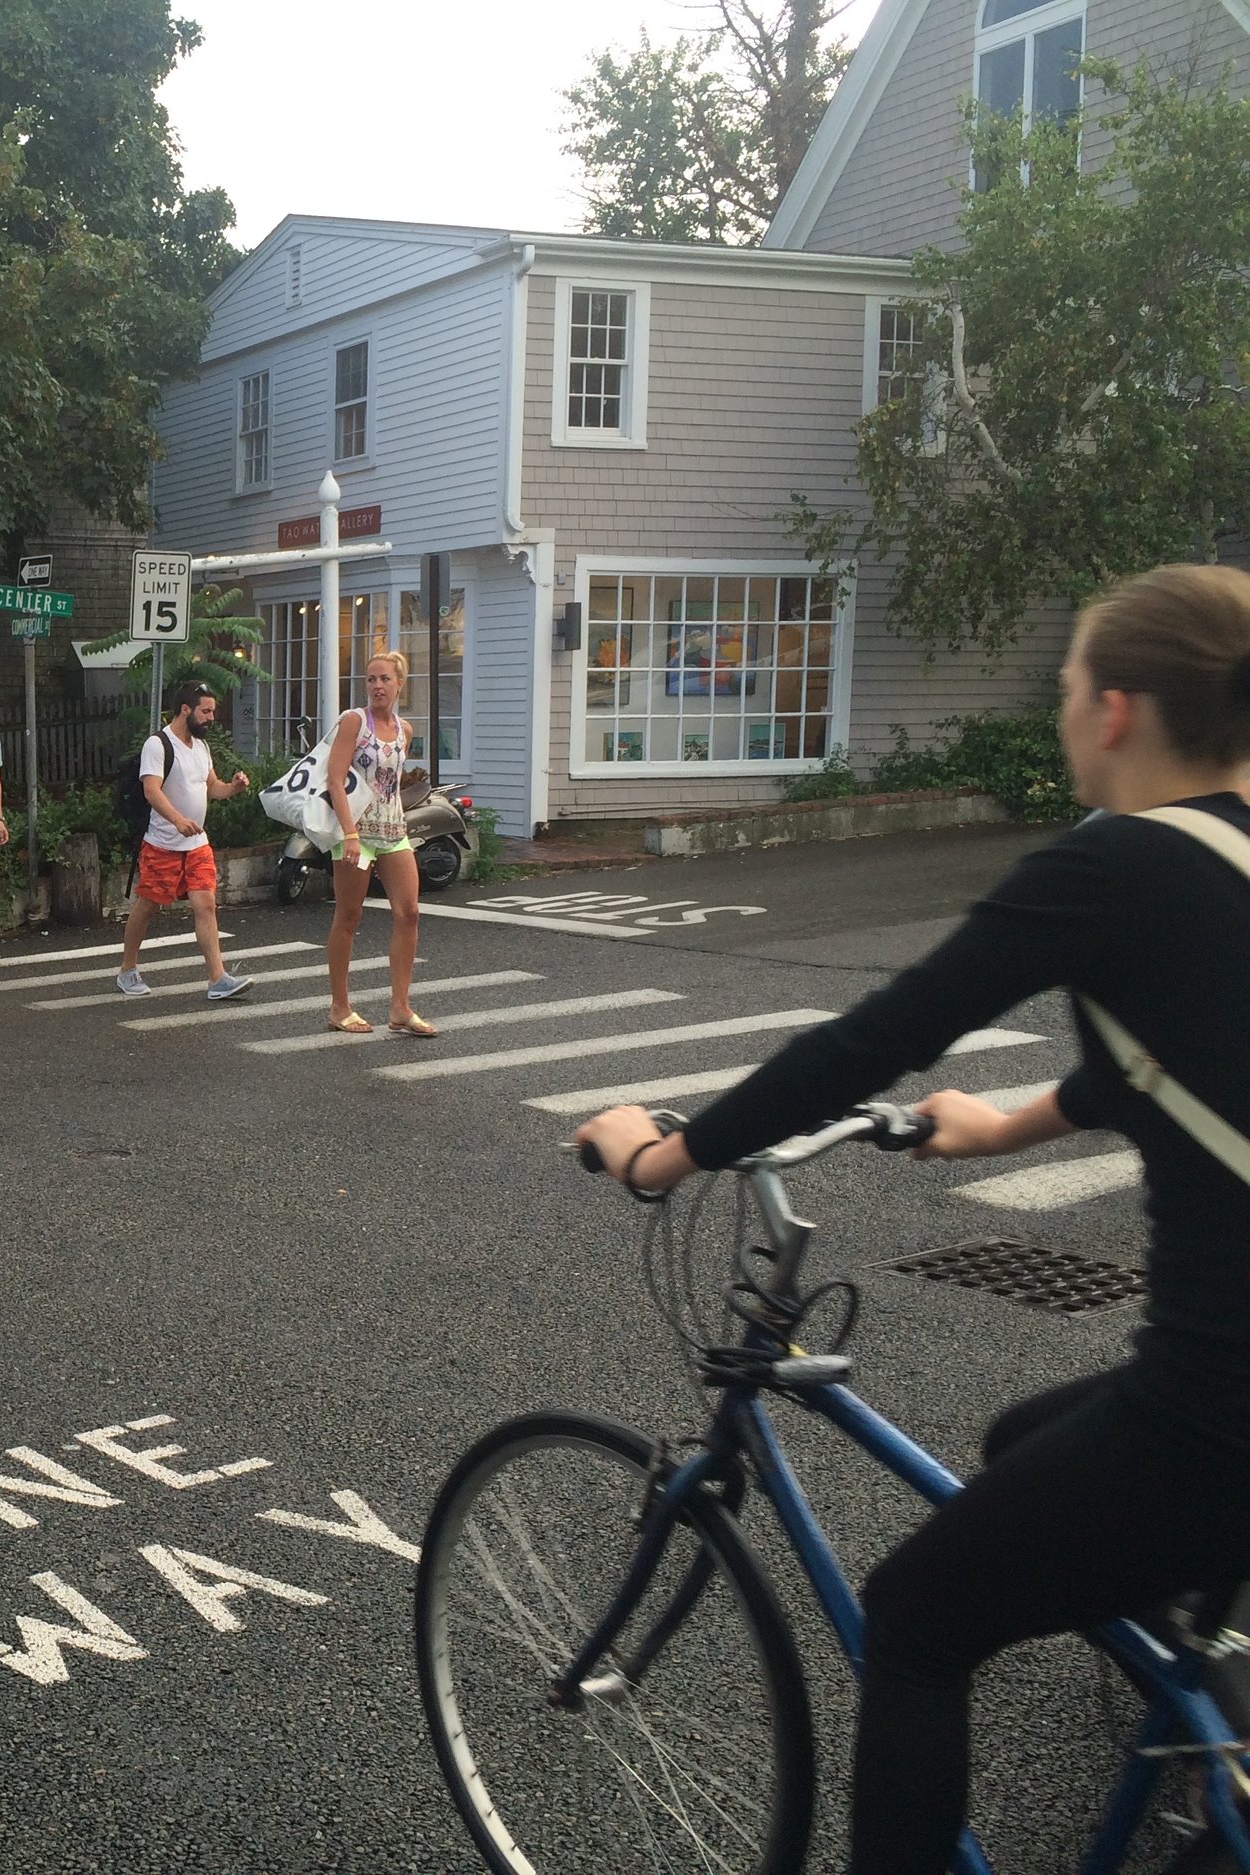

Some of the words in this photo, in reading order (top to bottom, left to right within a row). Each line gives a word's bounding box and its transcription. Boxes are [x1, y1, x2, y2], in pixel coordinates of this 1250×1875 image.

[282, 526, 300, 539] TAO
[340, 513, 375, 530] ALLERY
[28, 566, 38, 577] ONE
[38, 565, 48, 576] WAY
[138, 562, 186, 576] SPEED
[143, 582, 180, 595] LIMIT
[57, 600, 67, 610] ST
[142, 600, 178, 633] 15
[12, 617, 44, 636] COMMERCIAL
[466, 891, 767, 926] STOP
